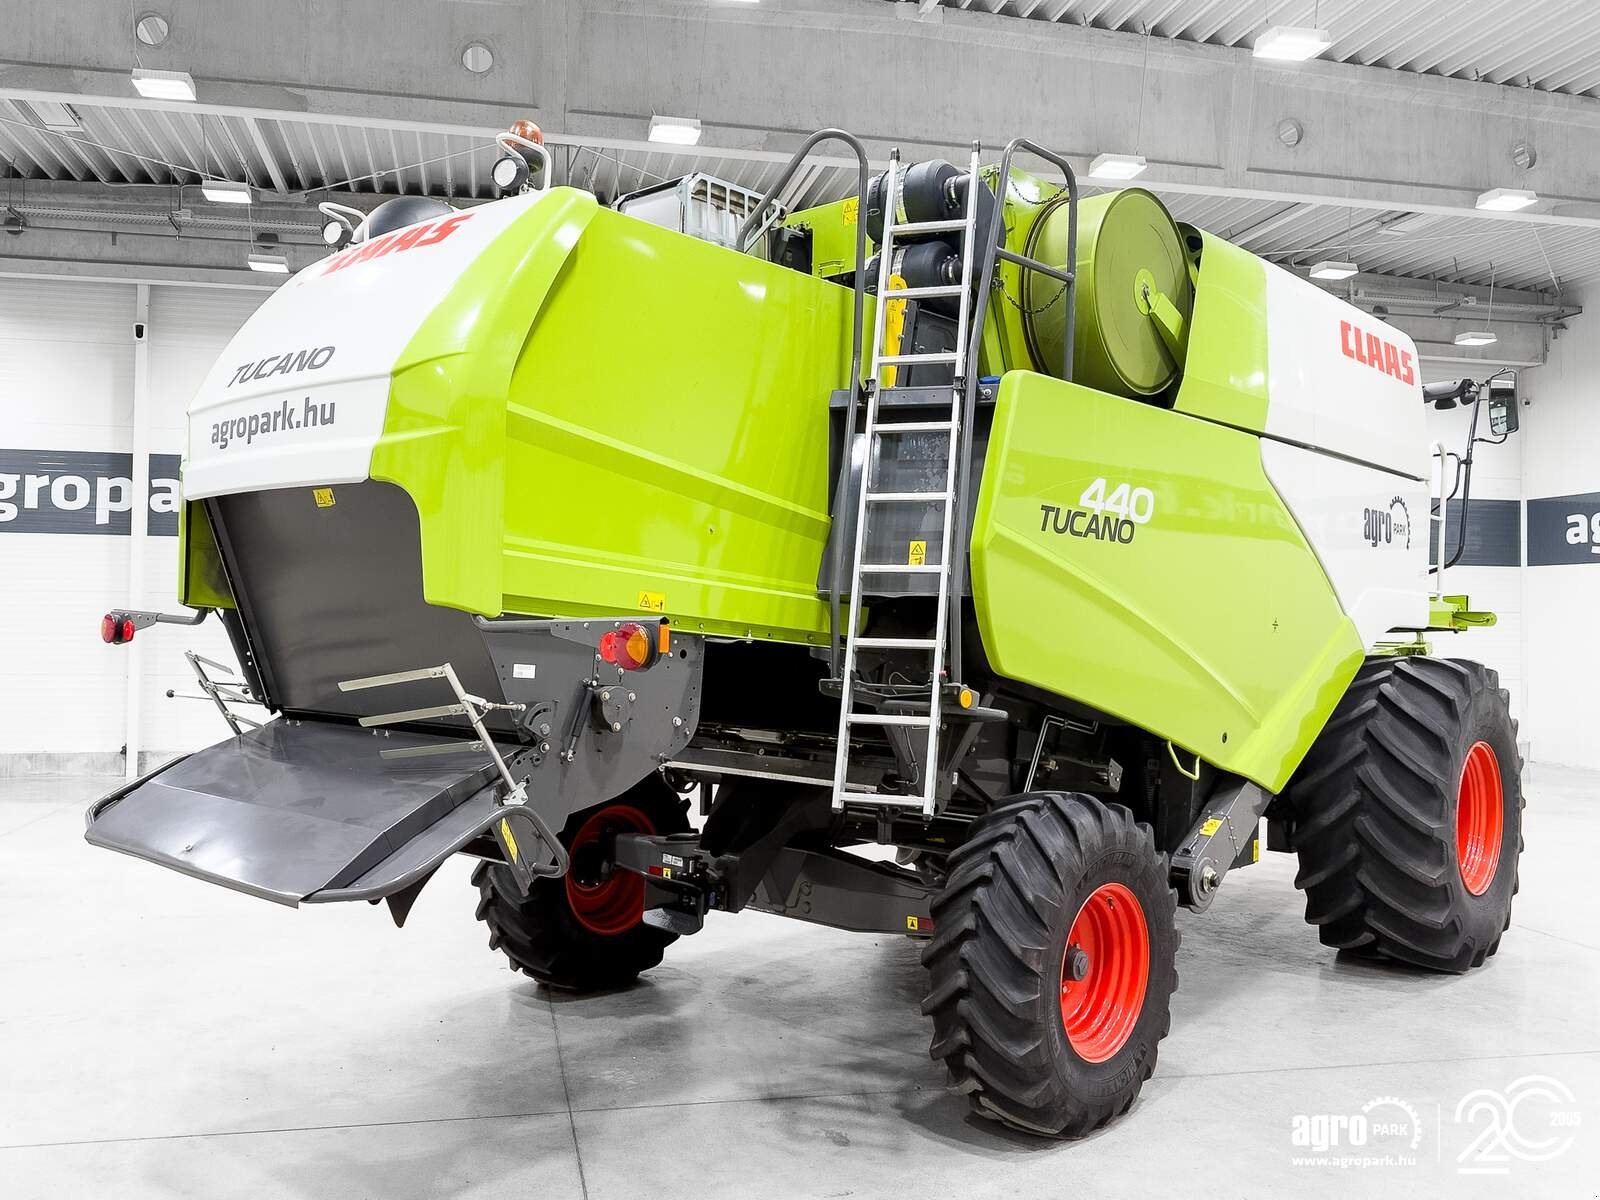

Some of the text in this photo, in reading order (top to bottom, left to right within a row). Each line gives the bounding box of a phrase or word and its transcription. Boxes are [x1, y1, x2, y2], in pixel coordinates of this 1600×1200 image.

[227, 346, 336, 388] TUCANO
[1340, 319, 1414, 386] CLAAS
[211, 397, 336, 449] agropark.hu
[1078, 477, 1155, 524] 440
[1040, 504, 1136, 545] TUCANO
[1363, 507, 1392, 548] agro
